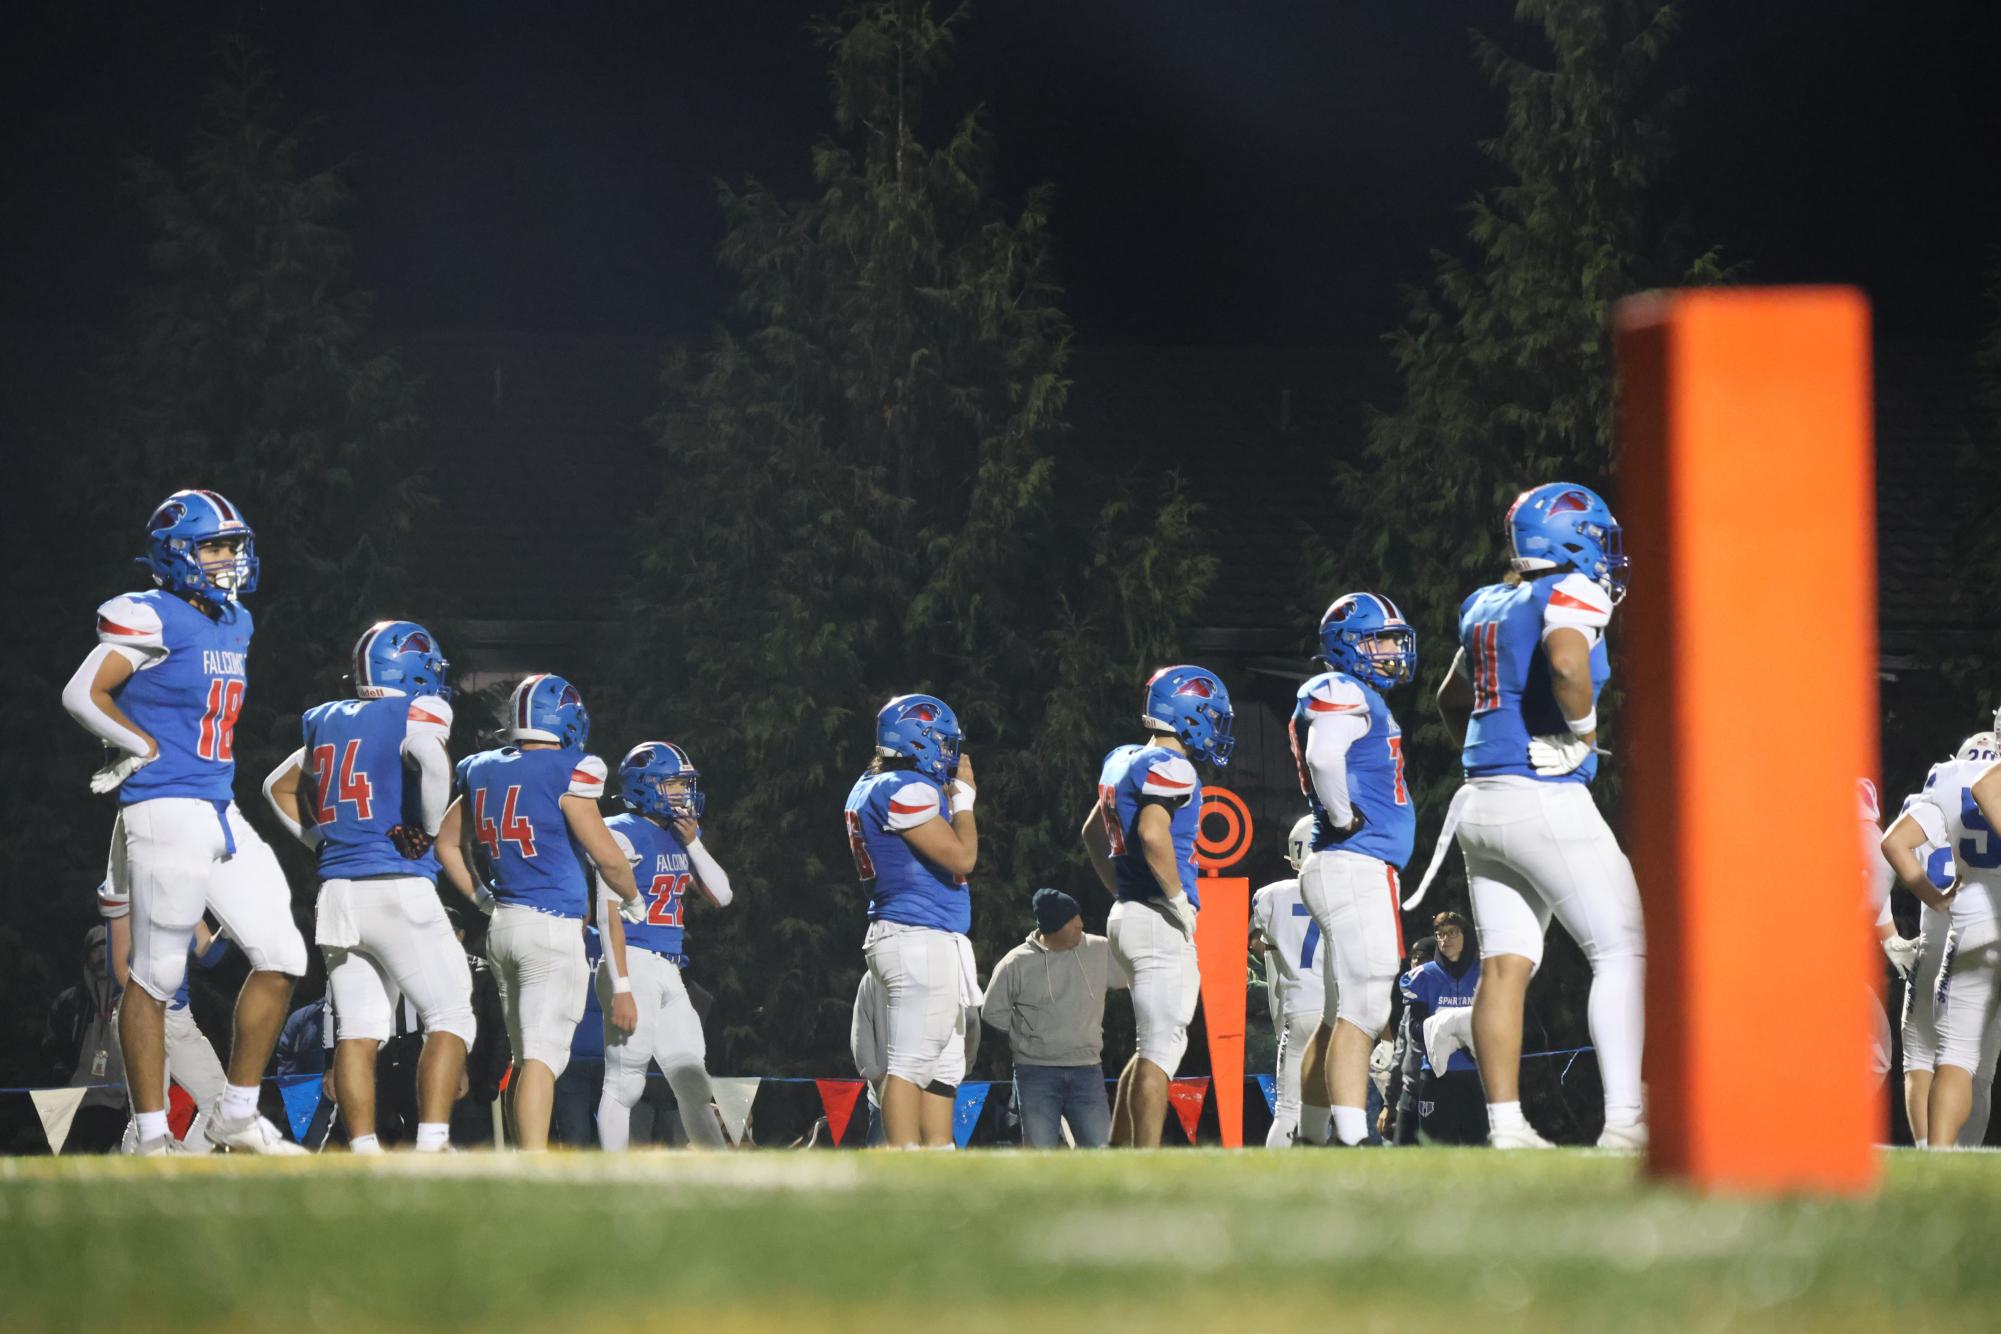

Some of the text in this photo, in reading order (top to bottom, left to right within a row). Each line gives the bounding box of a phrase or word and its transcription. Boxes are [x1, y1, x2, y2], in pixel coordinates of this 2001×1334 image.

[1472, 621, 1501, 713] 11
[197, 678, 245, 762] 18
[313, 738, 374, 826] 24
[475, 785, 538, 859] 44
[1294, 840, 1304, 859] 7
[1292, 903, 1321, 969] 7
